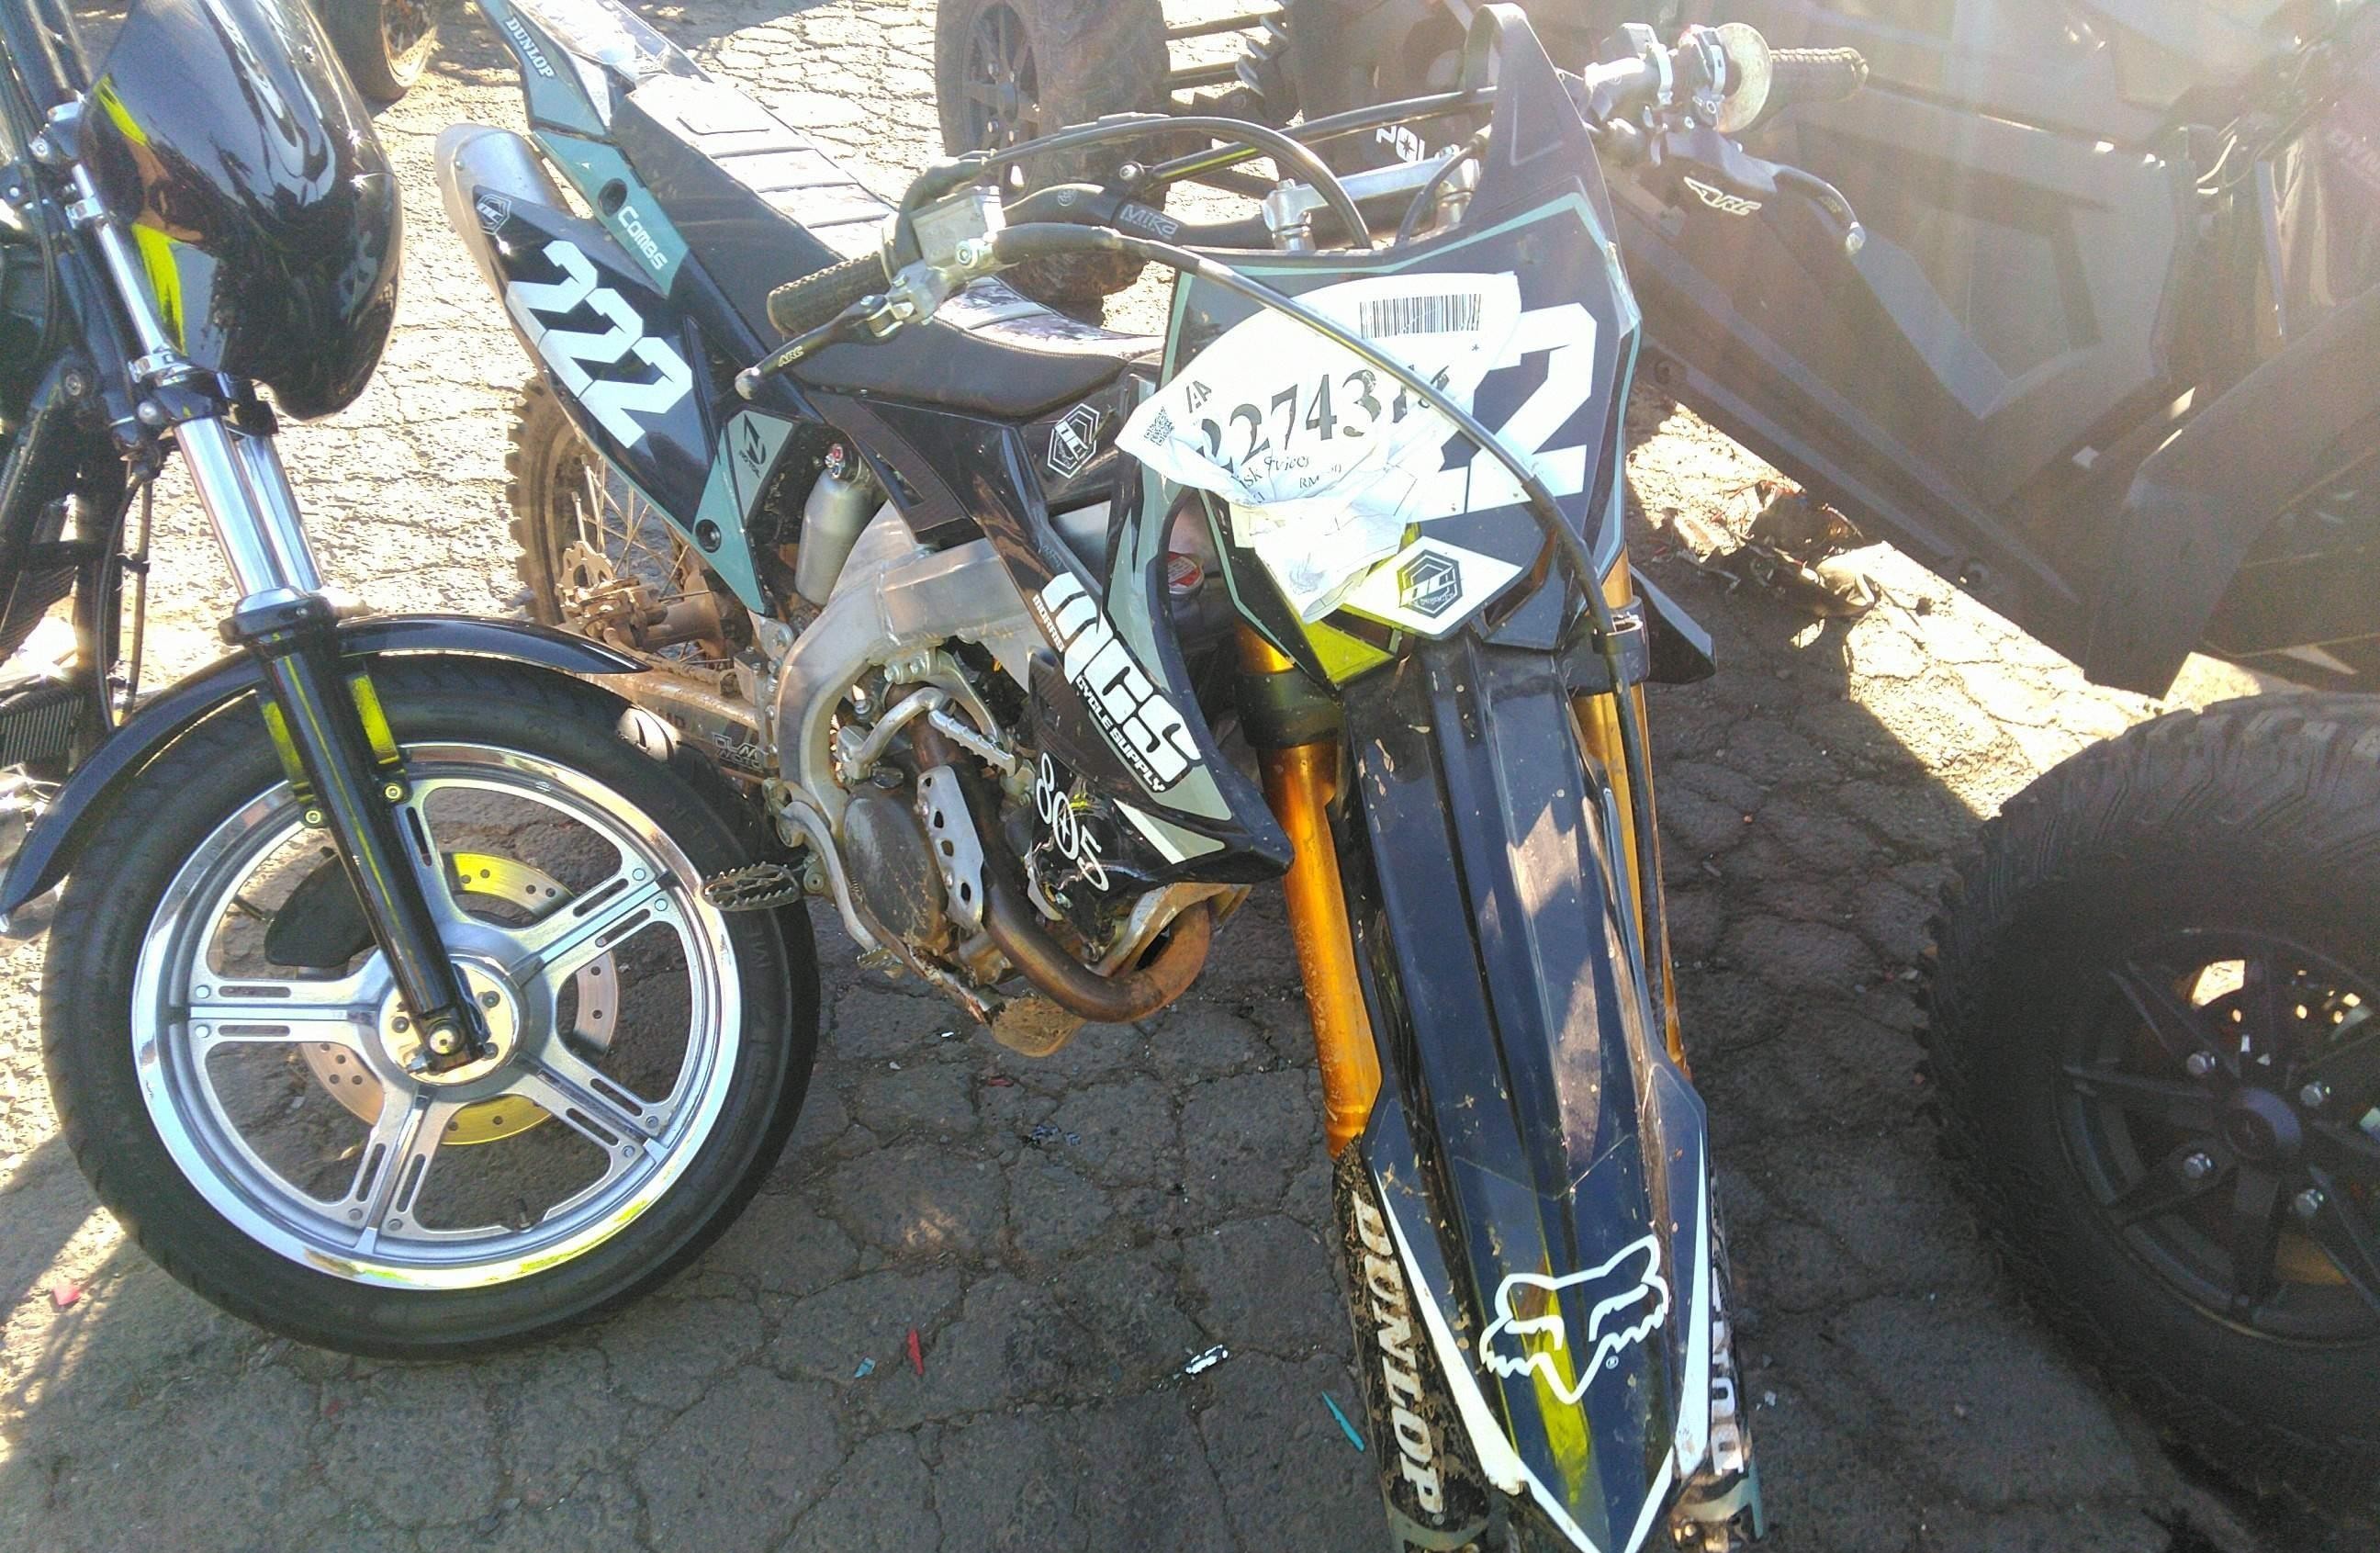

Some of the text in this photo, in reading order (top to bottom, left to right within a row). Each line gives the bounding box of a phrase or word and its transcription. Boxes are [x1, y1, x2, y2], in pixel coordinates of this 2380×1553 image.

[505, 17, 556, 79] DUNLOP
[506, 240, 693, 449] 222
[1032, 594, 1065, 653] MORRIS
[1075, 675, 1166, 793] CYCLE SUPPLY
[1036, 752, 1109, 892] 805
[1352, 1191, 1443, 1514] DUNLOP
